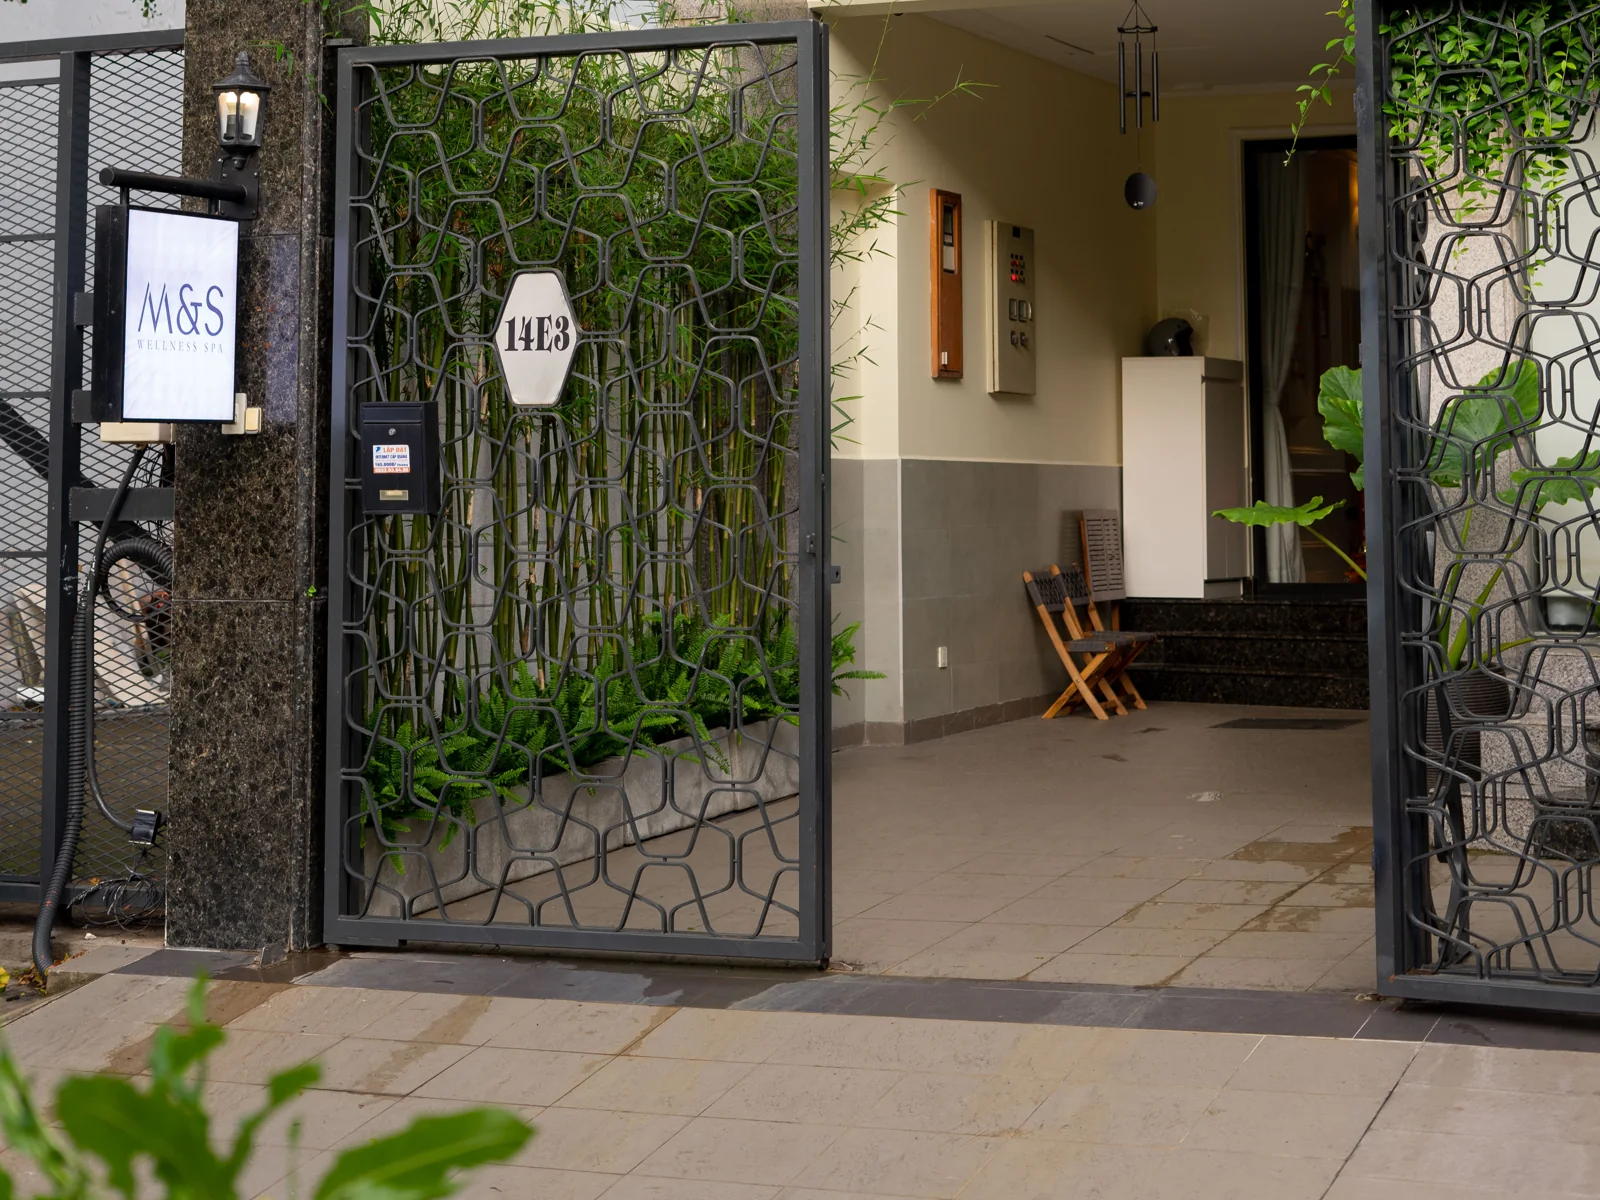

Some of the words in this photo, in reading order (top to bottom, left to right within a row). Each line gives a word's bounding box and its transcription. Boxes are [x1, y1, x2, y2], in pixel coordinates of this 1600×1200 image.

[137, 282, 224, 336] M&S
[137, 340, 198, 352] WELLNESS
[204, 343, 224, 353] SPA
[504, 314, 570, 353] 14E3
